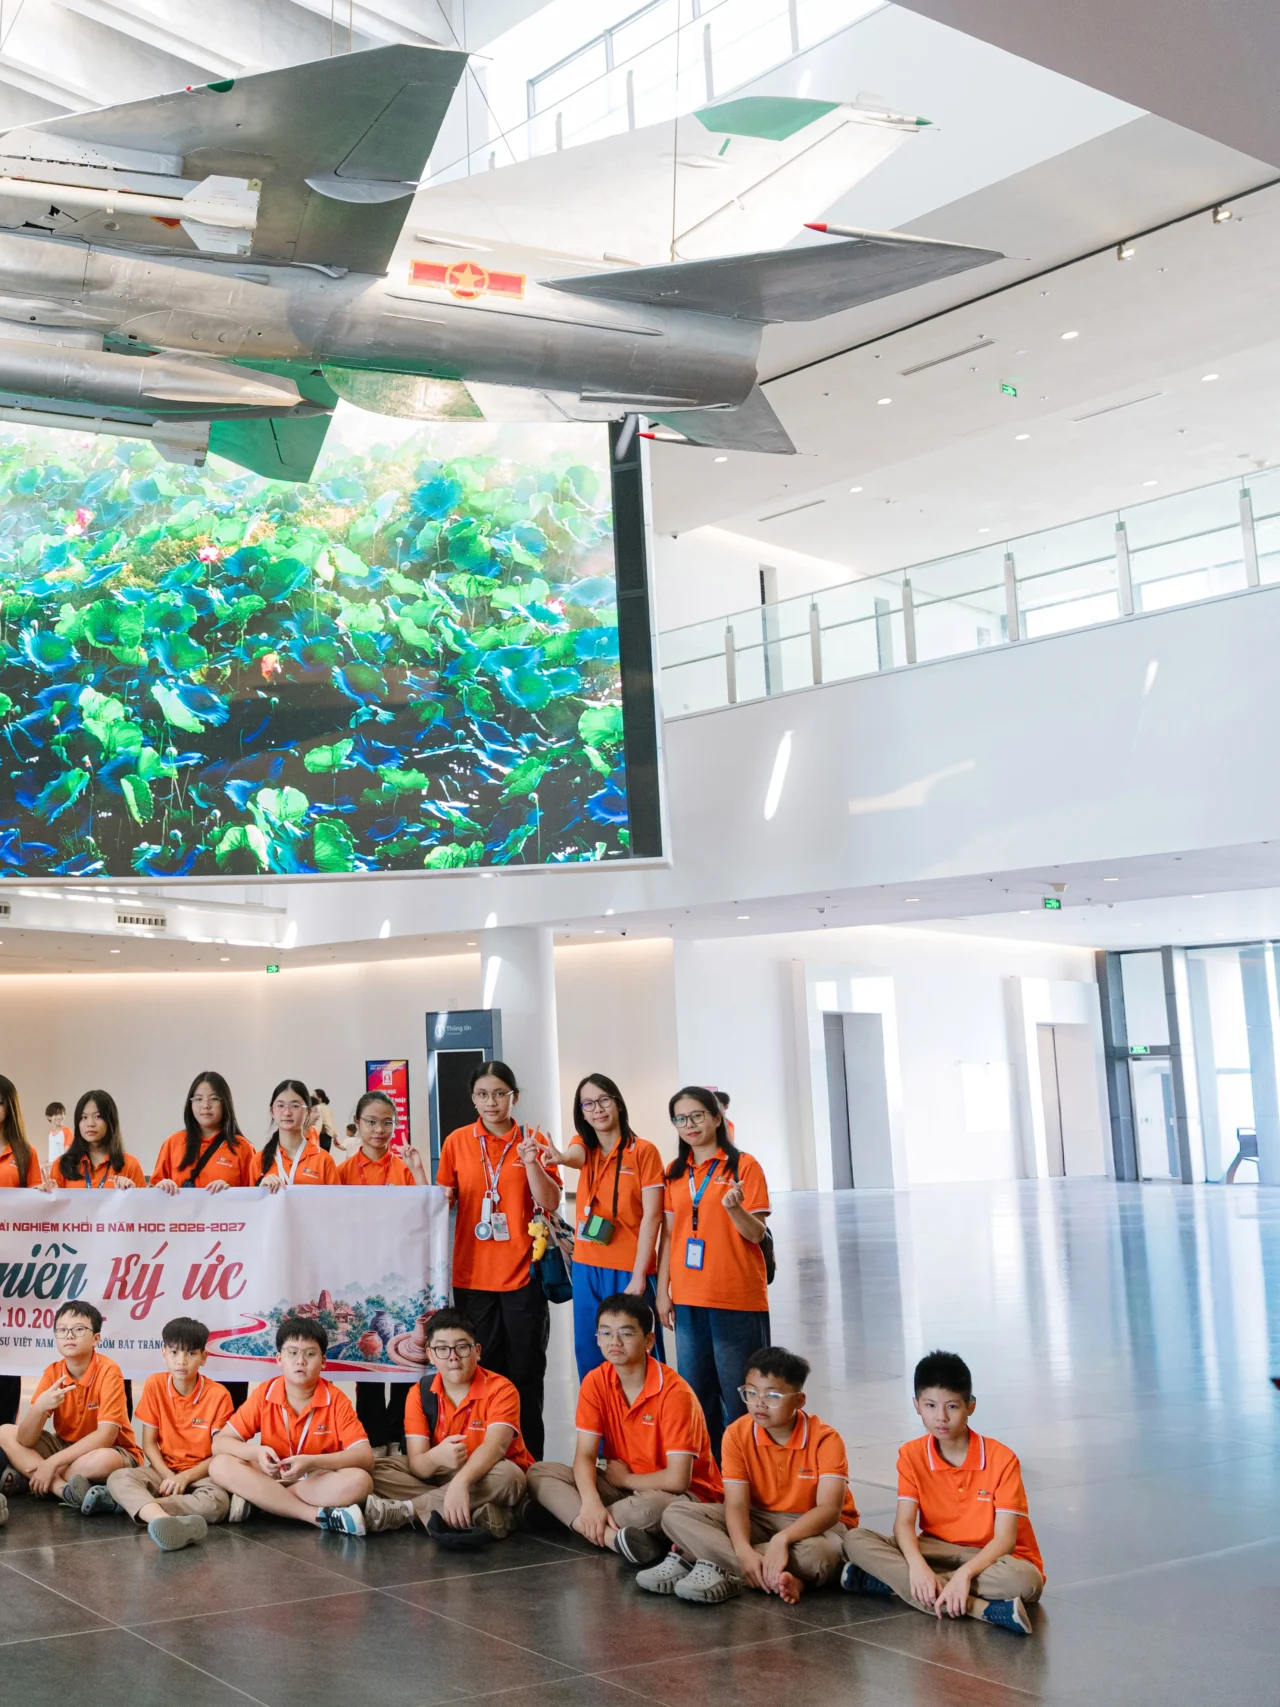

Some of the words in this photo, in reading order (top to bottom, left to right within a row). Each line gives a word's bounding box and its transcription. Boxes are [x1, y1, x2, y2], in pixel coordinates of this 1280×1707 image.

[96, 1222, 105, 1233] 8
[108, 1221, 135, 1233] NĂM
[138, 1222, 166, 1234] HỌC
[169, 1222, 246, 1233] 2026-2027
[181, 1240, 248, 1301] ức
[0, 1336, 11, 1347] SỰ
[13, 1336, 32, 1348] VIỆT
[35, 1338, 54, 1348] NAM
[97, 1337, 115, 1349] GỐM
